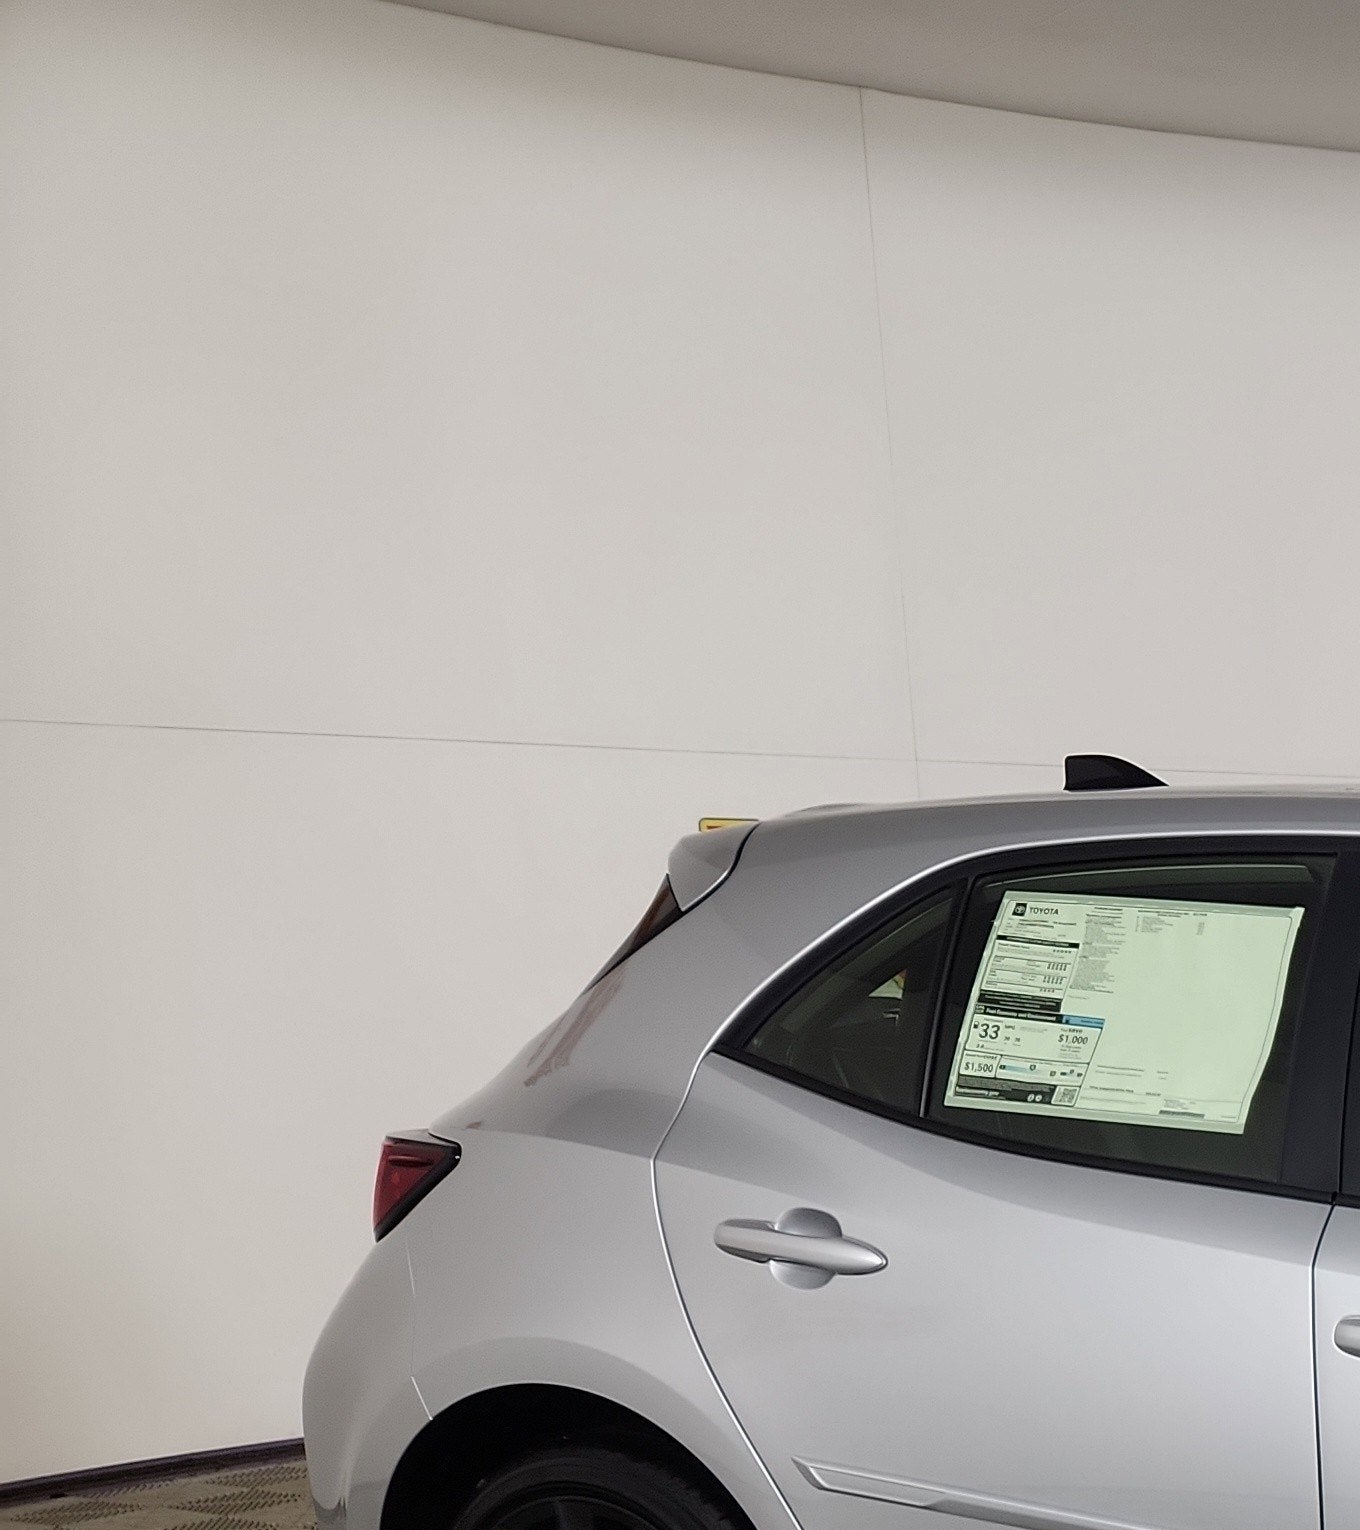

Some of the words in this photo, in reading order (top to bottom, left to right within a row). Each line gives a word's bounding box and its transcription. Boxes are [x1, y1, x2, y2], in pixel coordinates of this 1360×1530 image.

[1028, 906, 1060, 916] TOYOTA
[978, 1023, 1001, 1040] 33
[1057, 1034, 1089, 1045] $1,000
[964, 1061, 994, 1073] $1,500
